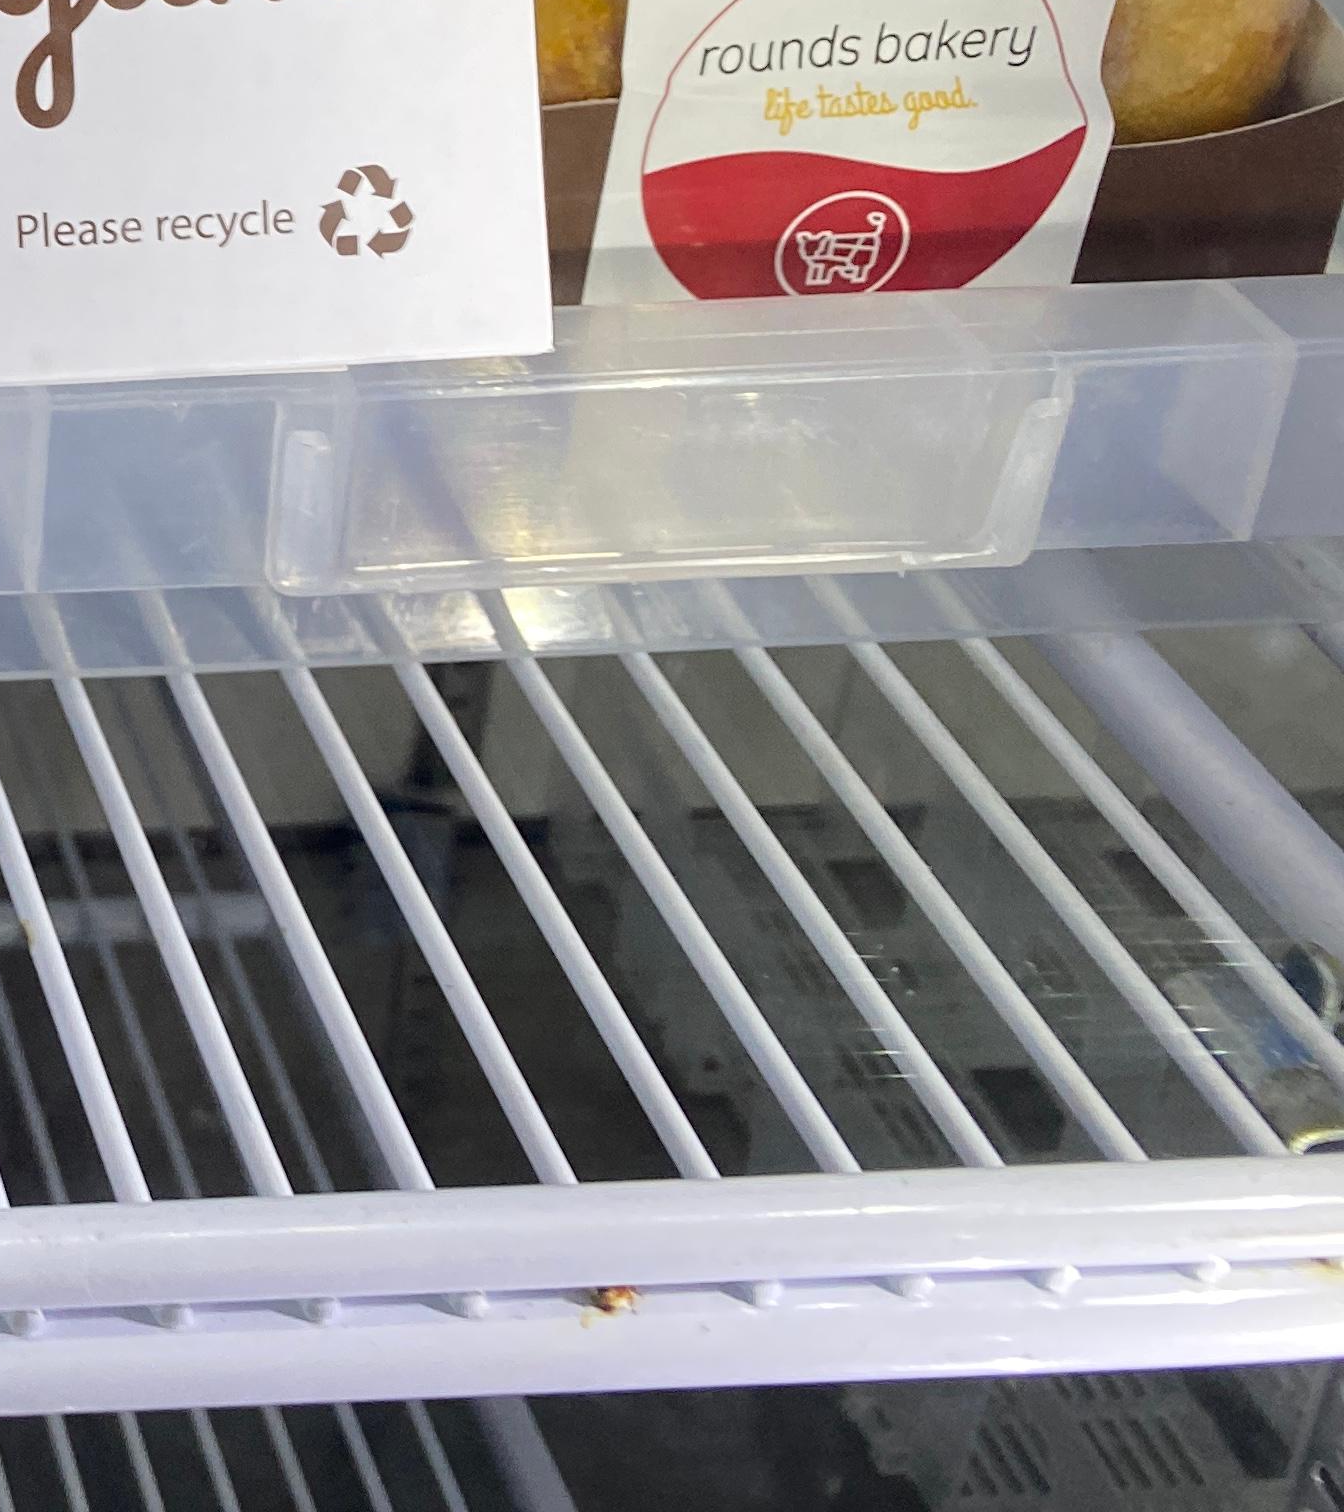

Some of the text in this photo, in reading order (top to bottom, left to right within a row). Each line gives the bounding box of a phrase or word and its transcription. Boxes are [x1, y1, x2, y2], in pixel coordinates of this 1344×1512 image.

[699, 19, 1038, 76] rounds bakery
[763, 76, 978, 136] life tastes good.
[16, 199, 296, 249] Please recycle
